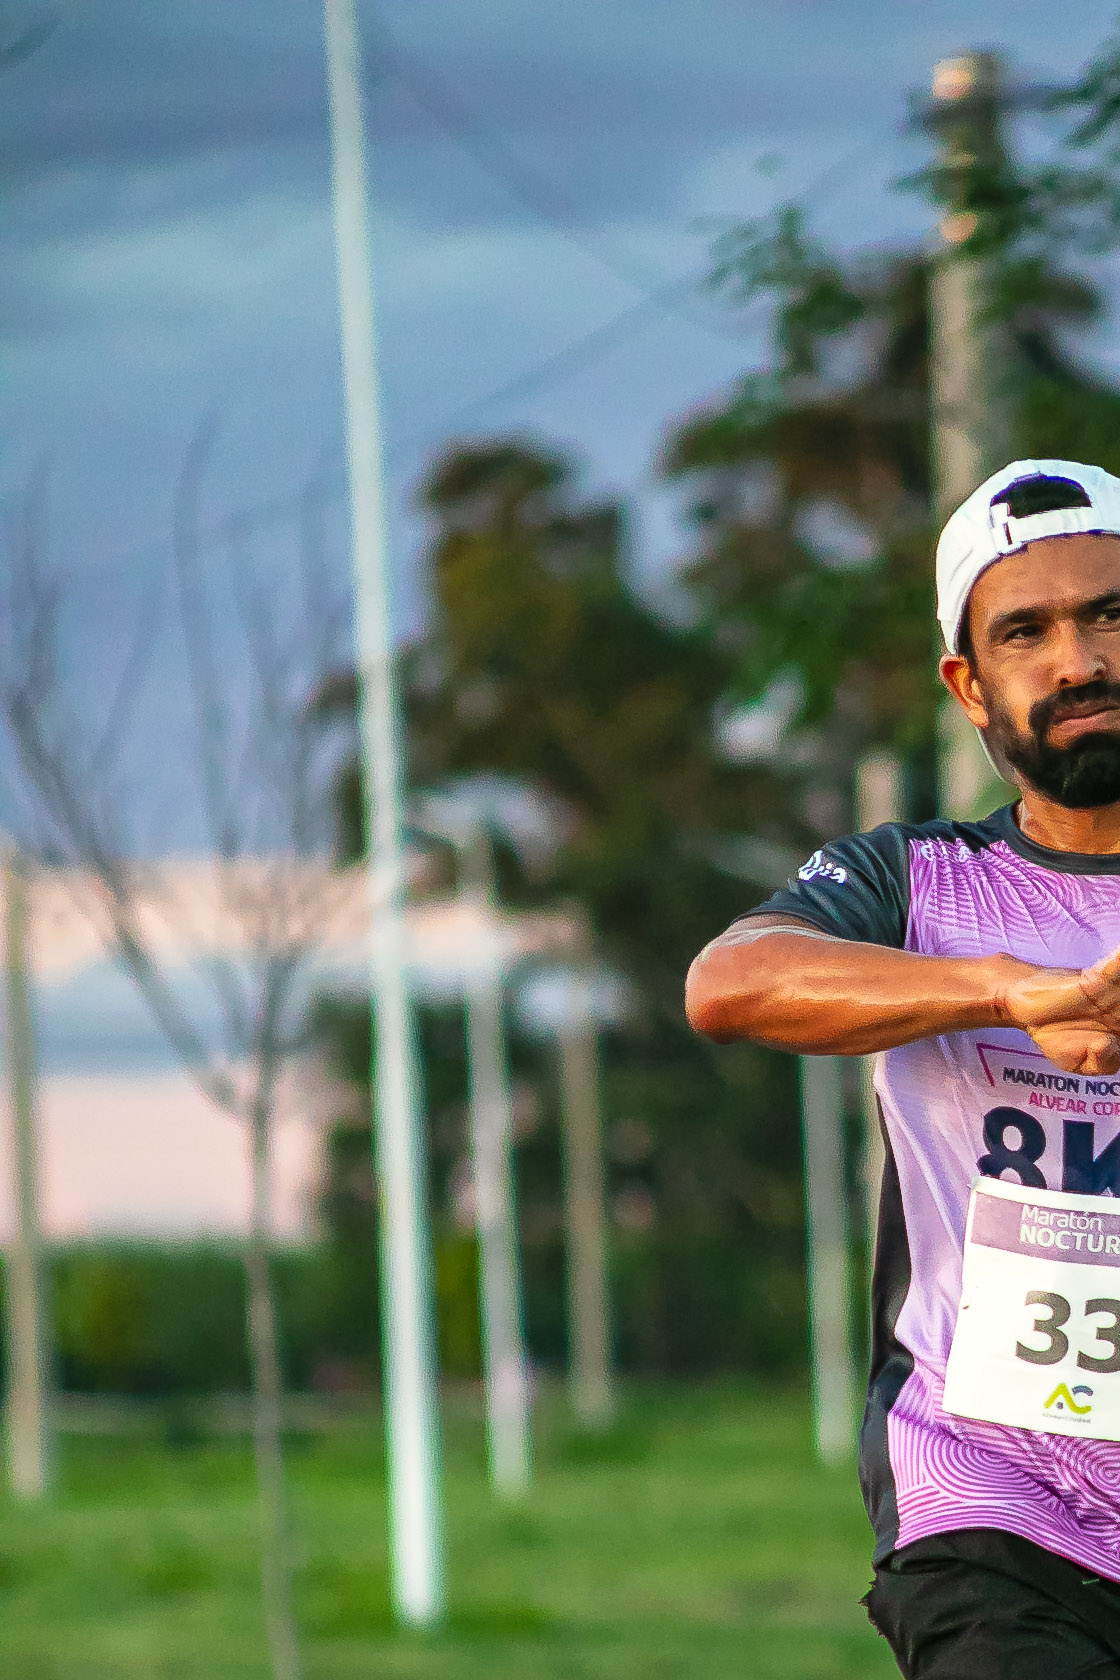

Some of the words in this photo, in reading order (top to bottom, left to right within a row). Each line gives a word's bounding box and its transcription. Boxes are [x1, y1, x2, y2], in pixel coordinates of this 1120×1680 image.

[1002, 1066, 1080, 1094] MARATON
[1029, 1091, 1087, 1114] ALVEAR
[1021, 1204, 1103, 1232] Maratón
